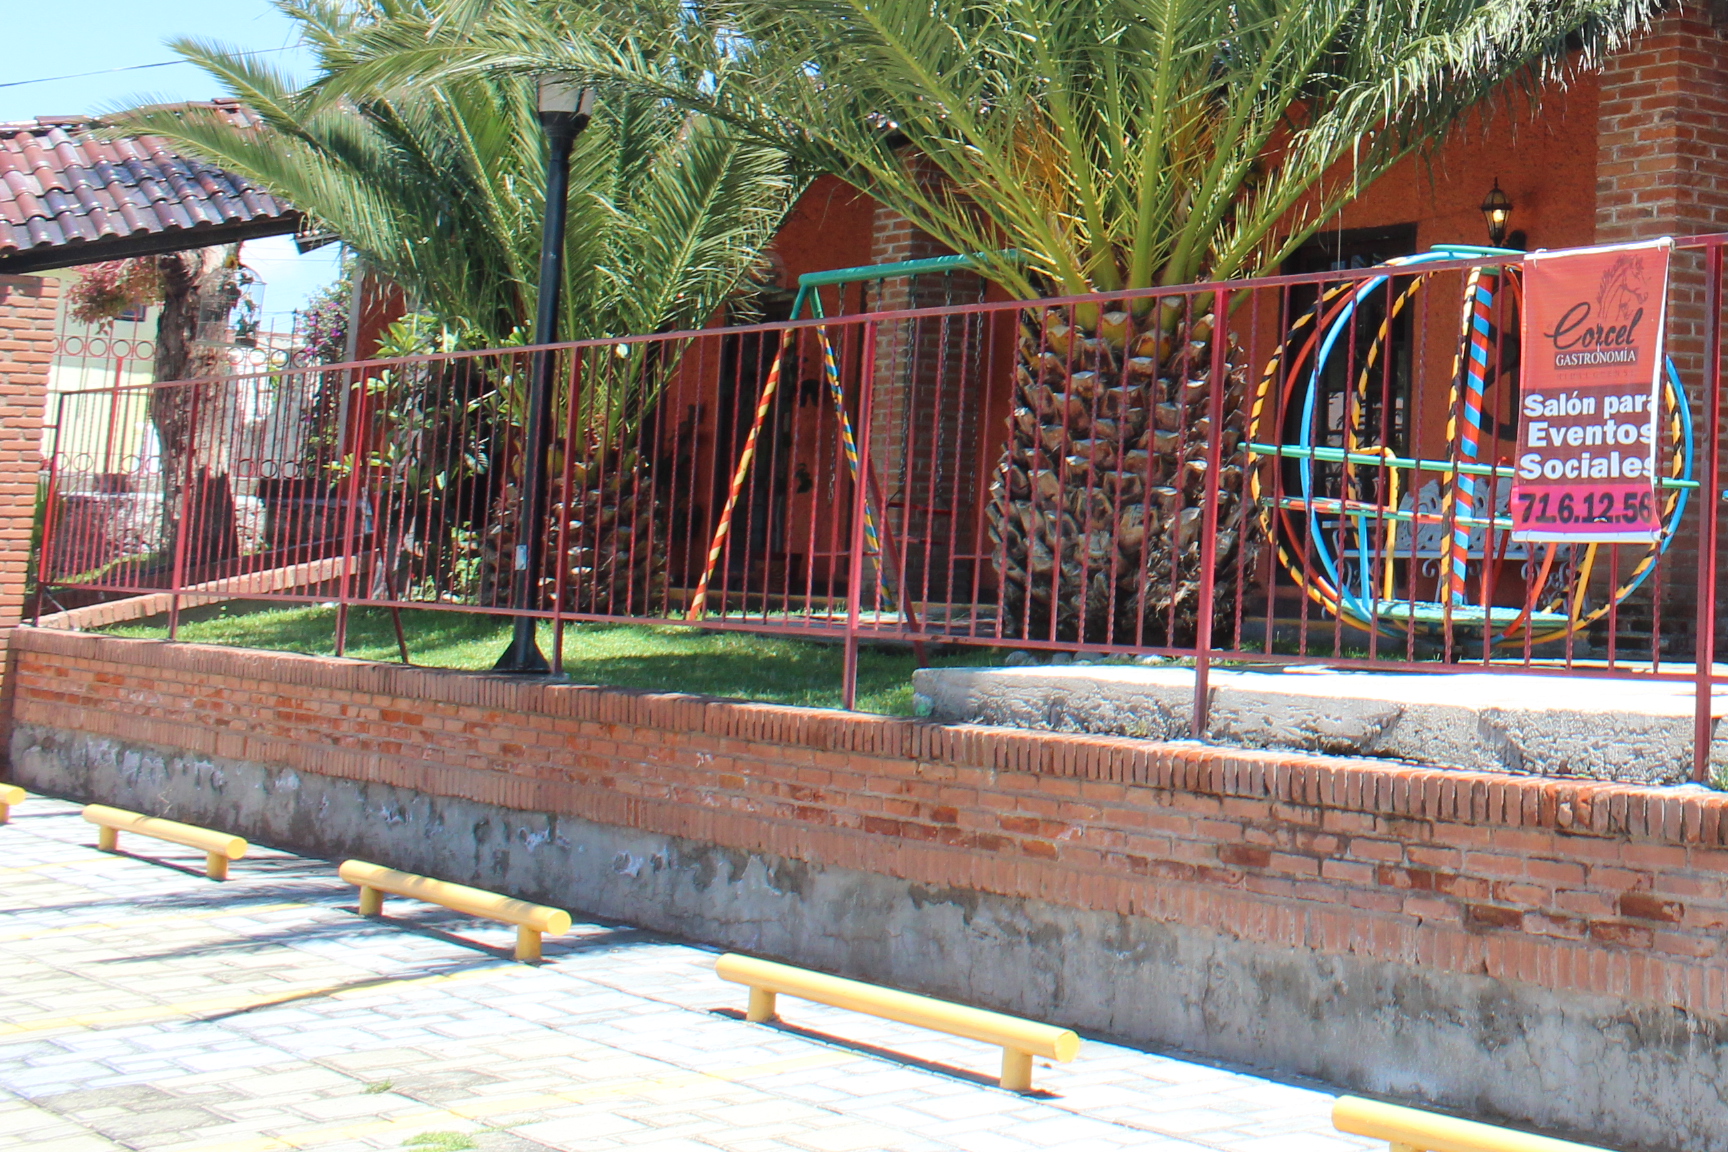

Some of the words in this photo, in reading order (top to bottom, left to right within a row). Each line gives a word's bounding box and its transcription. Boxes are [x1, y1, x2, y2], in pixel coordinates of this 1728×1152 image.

[1543, 301, 1643, 351] Corcel
[1555, 346, 1636, 367] GASTRONOMÍA
[1523, 390, 1595, 418] Salón
